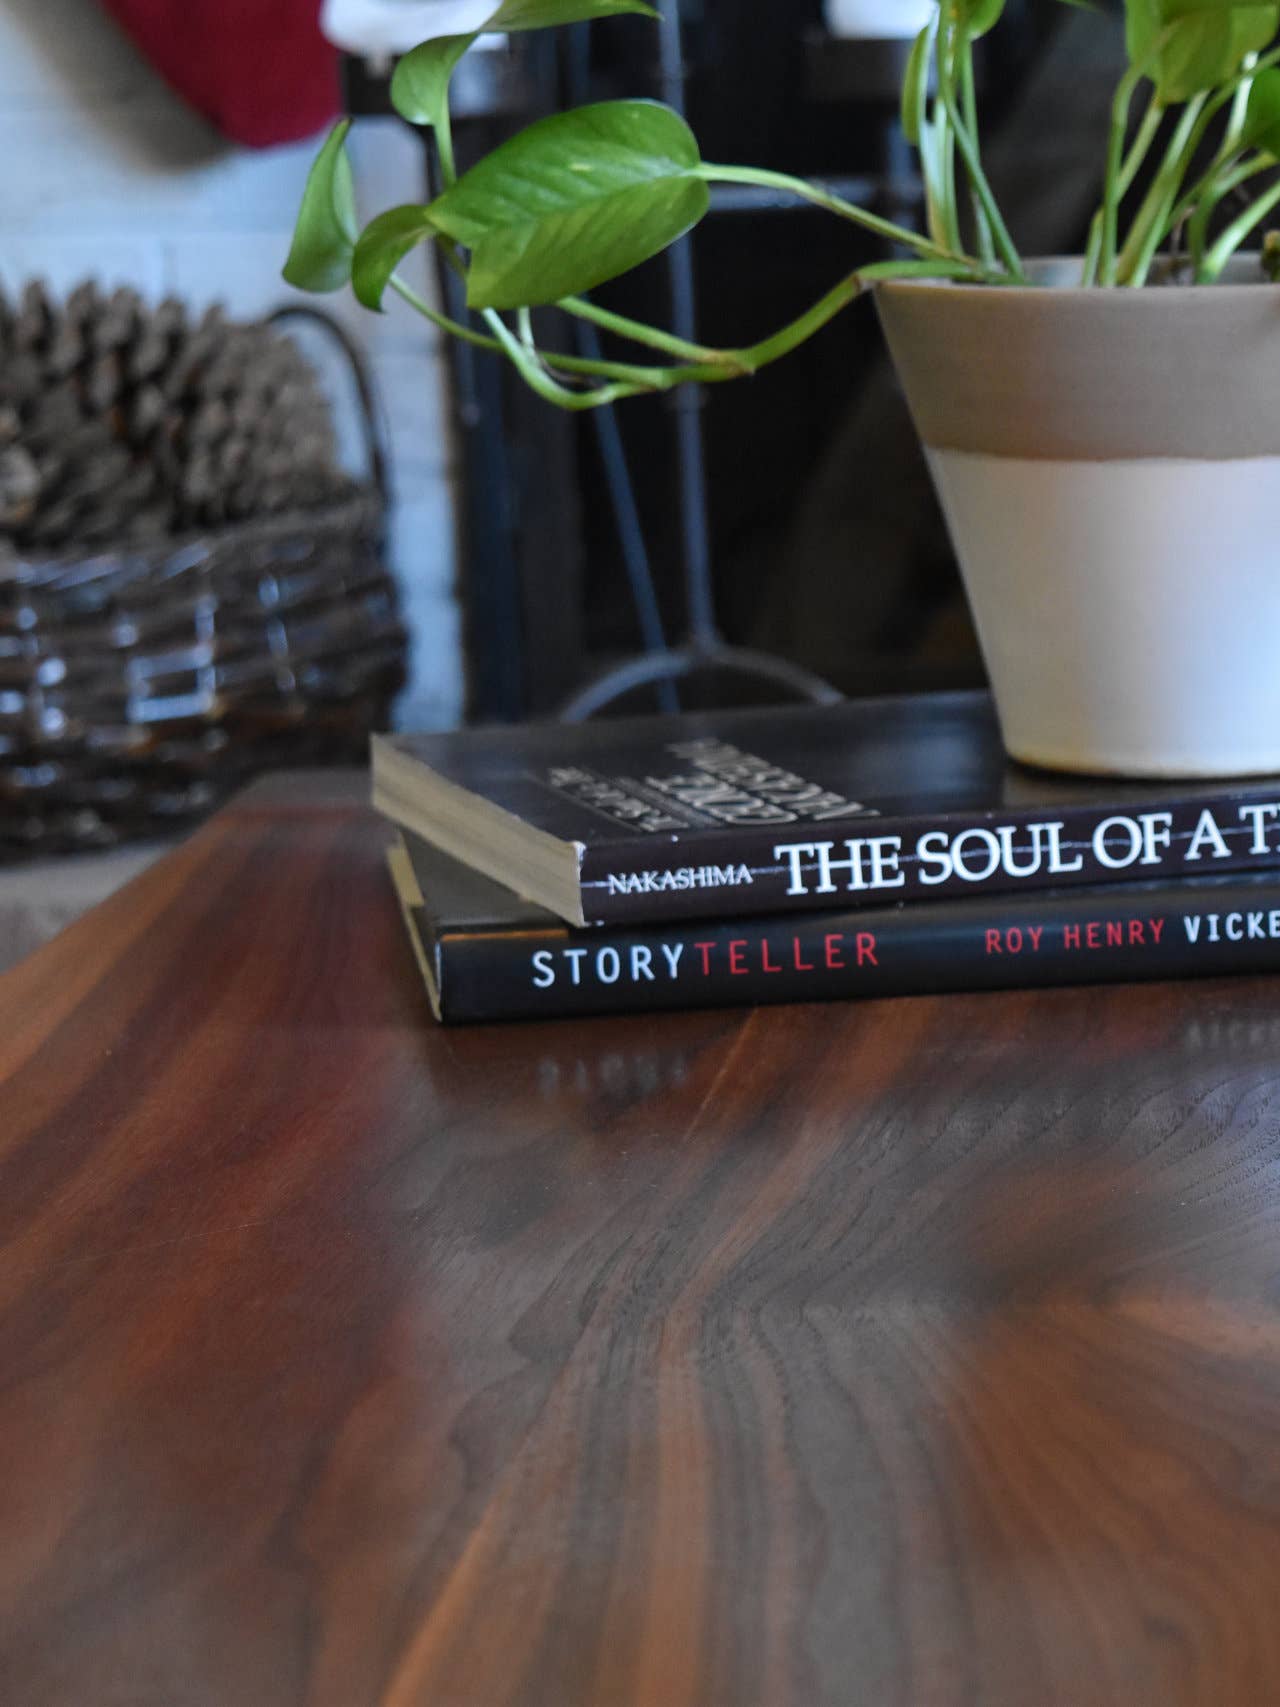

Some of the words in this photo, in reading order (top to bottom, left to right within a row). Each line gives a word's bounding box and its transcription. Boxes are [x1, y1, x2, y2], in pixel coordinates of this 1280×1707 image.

[606, 863, 754, 896] NAKASHIMA
[773, 836, 906, 896] THE
[915, 819, 1084, 885] SOUL
[1091, 811, 1173, 869] OF
[1184, 808, 1231, 861] A
[985, 926, 1043, 954] ROY
[1063, 918, 1166, 949] HENRY
